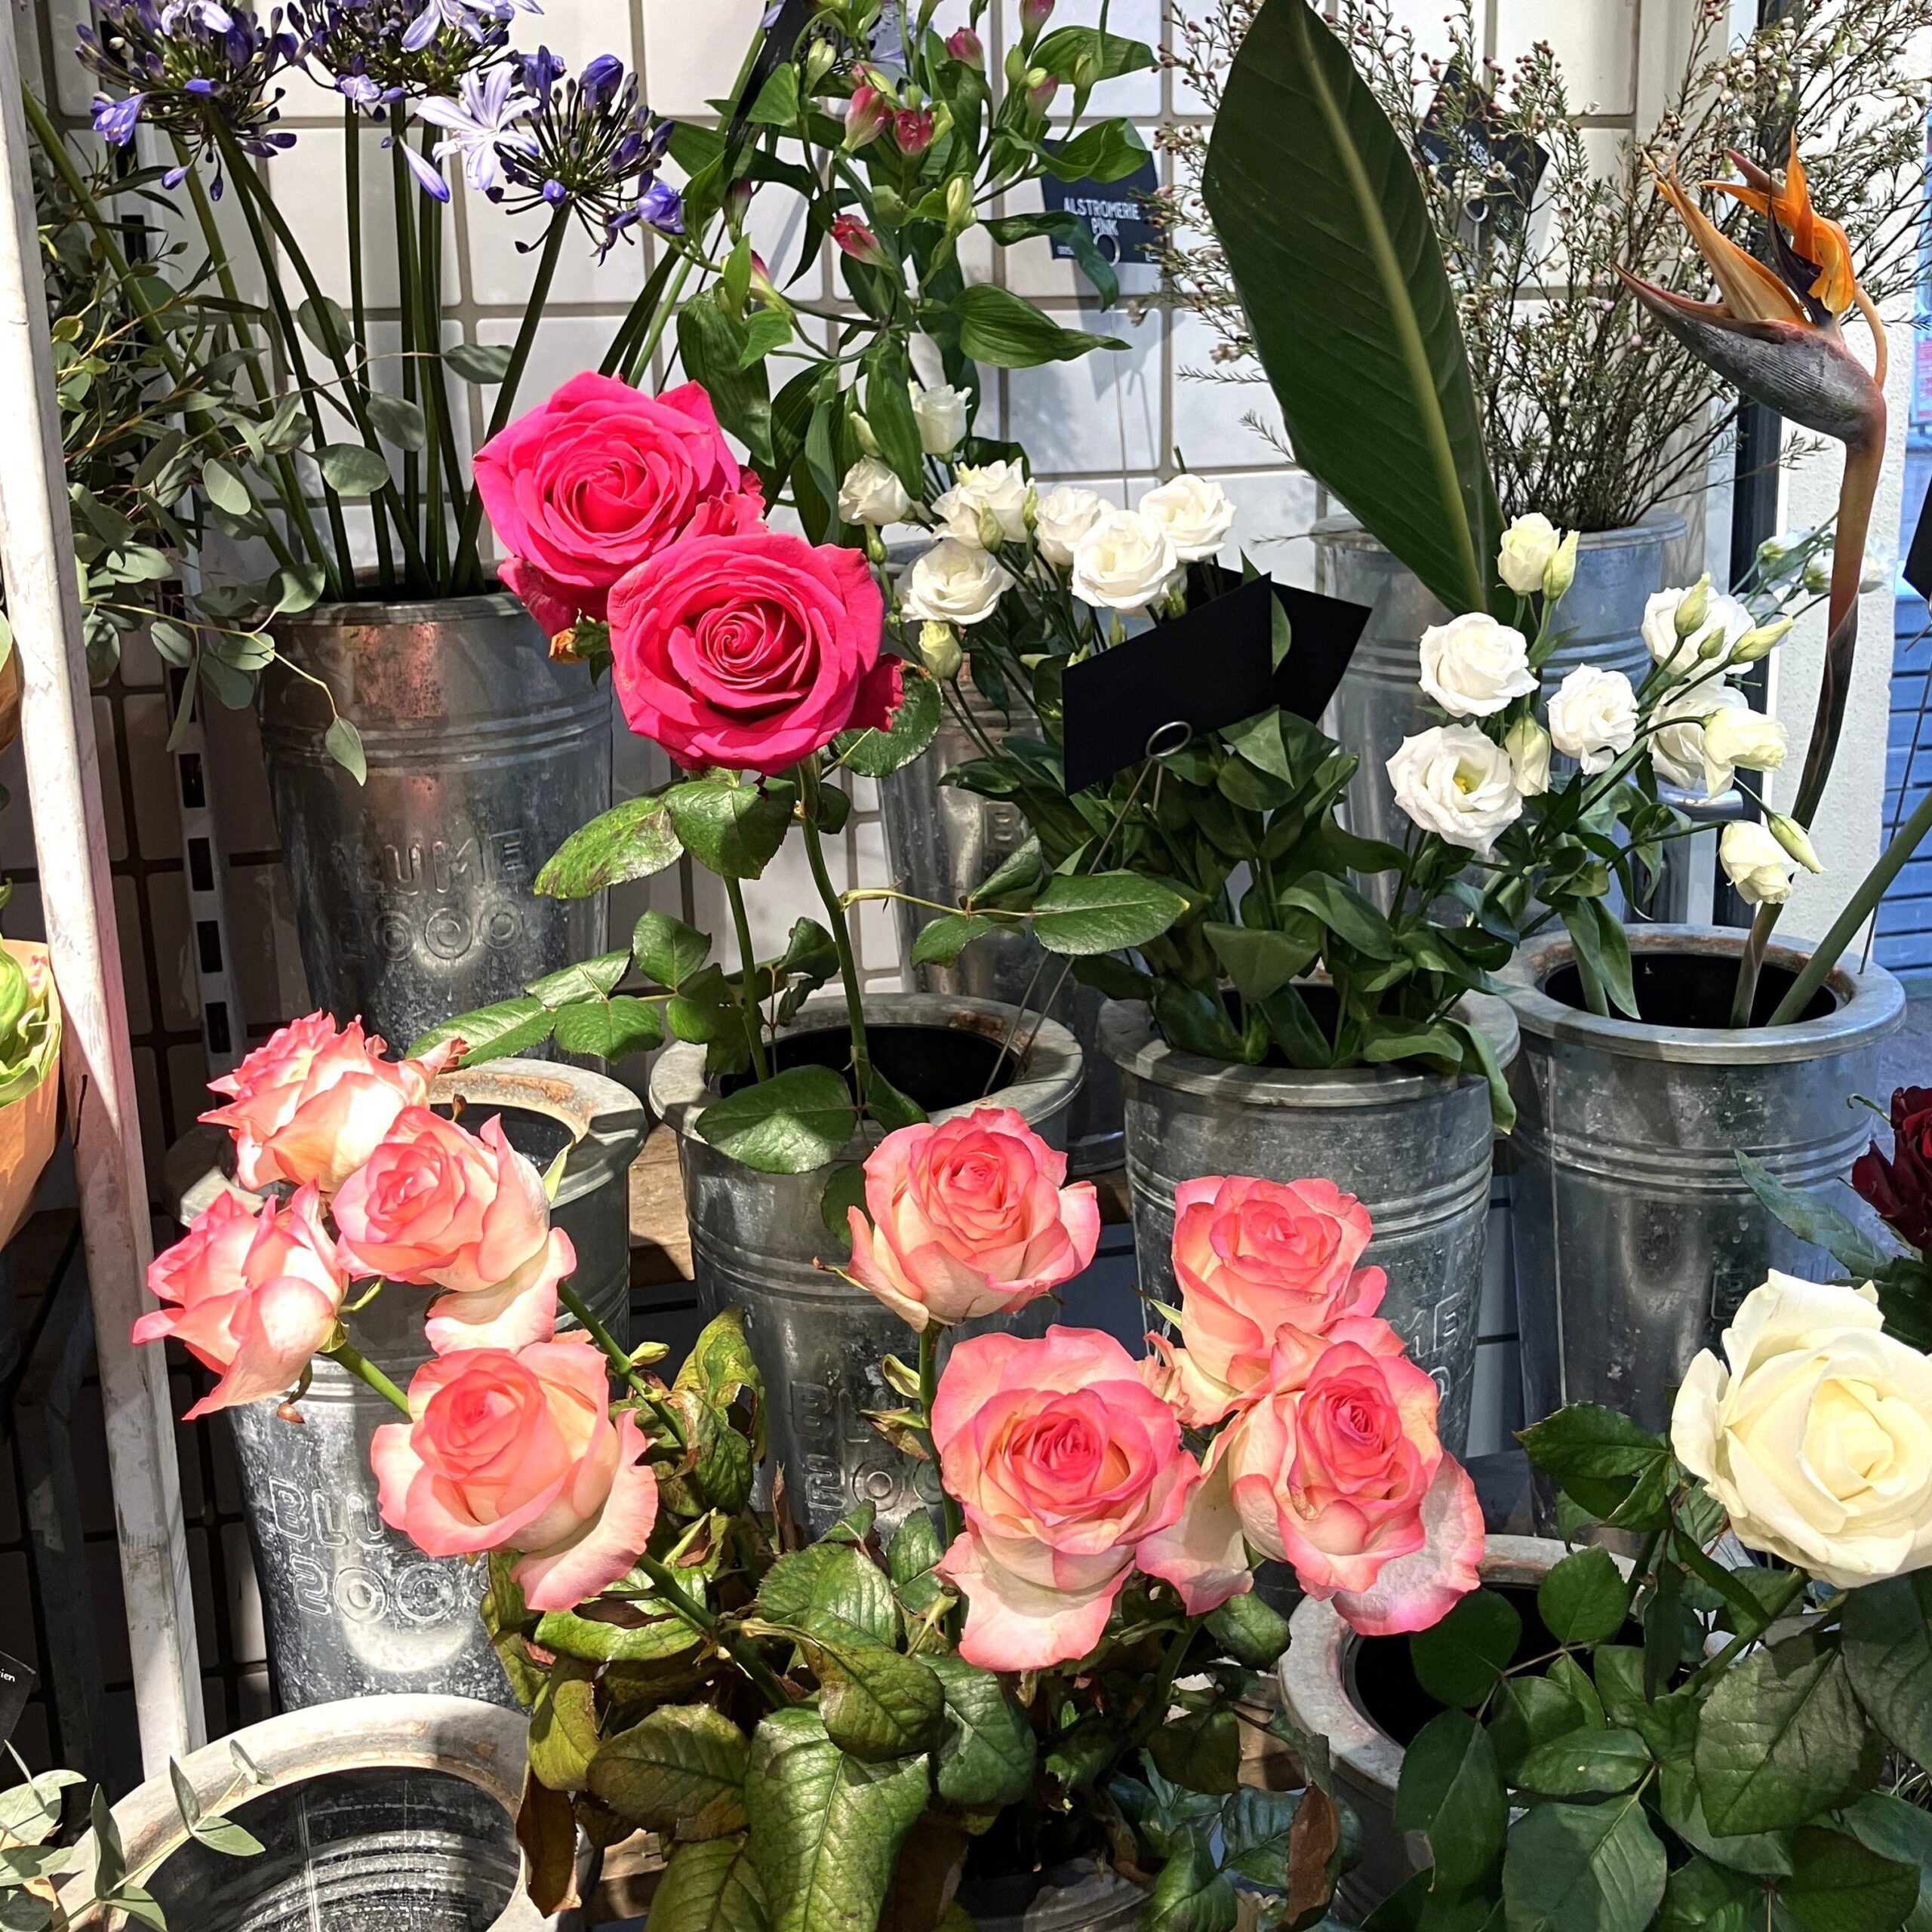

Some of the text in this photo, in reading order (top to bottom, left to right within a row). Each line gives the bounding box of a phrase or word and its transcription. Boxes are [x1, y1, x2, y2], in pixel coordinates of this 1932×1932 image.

[1063, 196, 1142, 220] ALSTROMERIE
[1091, 217, 1119, 235] PINK
[269, 1475, 392, 1549] BLU
[0, 1668, 15, 1682] ien
